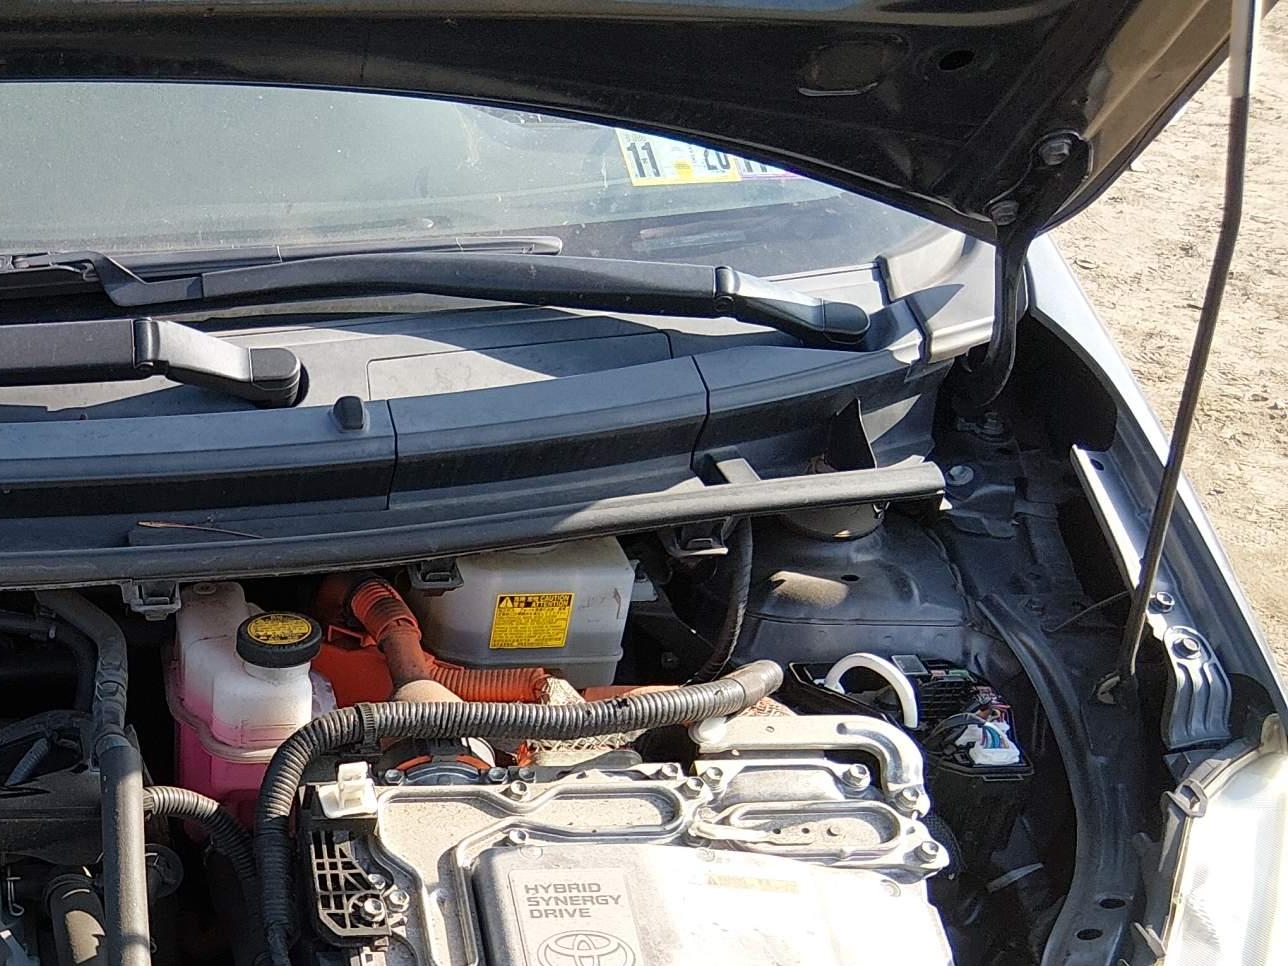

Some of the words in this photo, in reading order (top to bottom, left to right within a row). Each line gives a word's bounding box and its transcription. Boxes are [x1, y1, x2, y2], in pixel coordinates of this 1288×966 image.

[524, 883, 601, 894] HYBRID
[526, 895, 621, 906] SYNERGY
[529, 908, 591, 919] DRIVE
